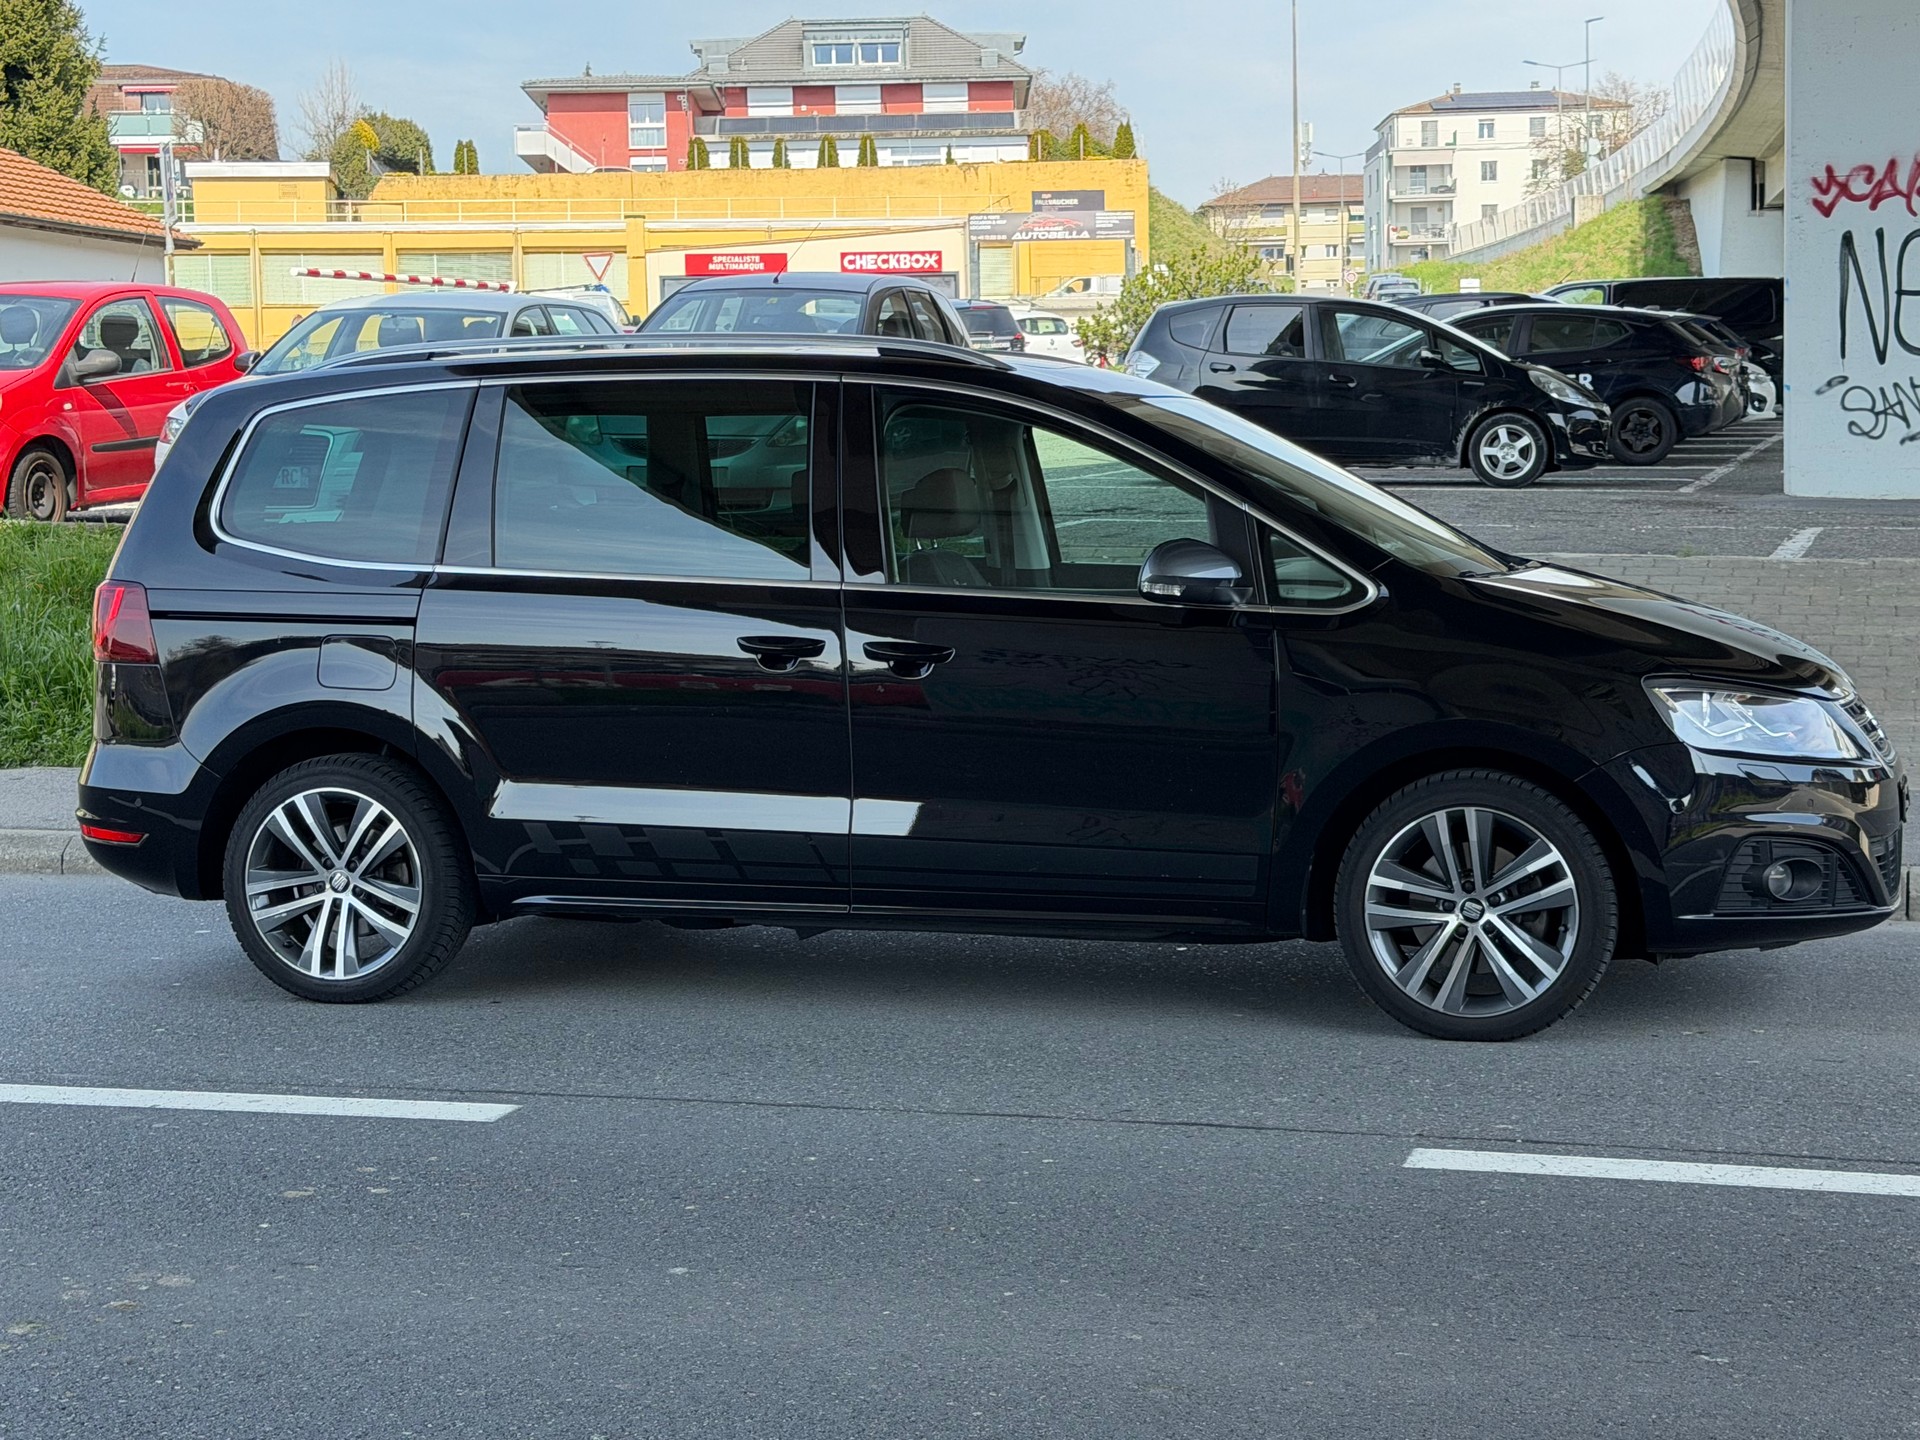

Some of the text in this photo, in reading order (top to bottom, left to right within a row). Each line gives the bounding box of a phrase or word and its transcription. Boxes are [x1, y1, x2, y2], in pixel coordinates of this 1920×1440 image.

[1011, 230, 1091, 240] AUTOBELLA
[712, 255, 760, 263] SPECIALISTE
[843, 253, 939, 270] CHECKBOX
[708, 262, 765, 271] MULTIMARQUE
